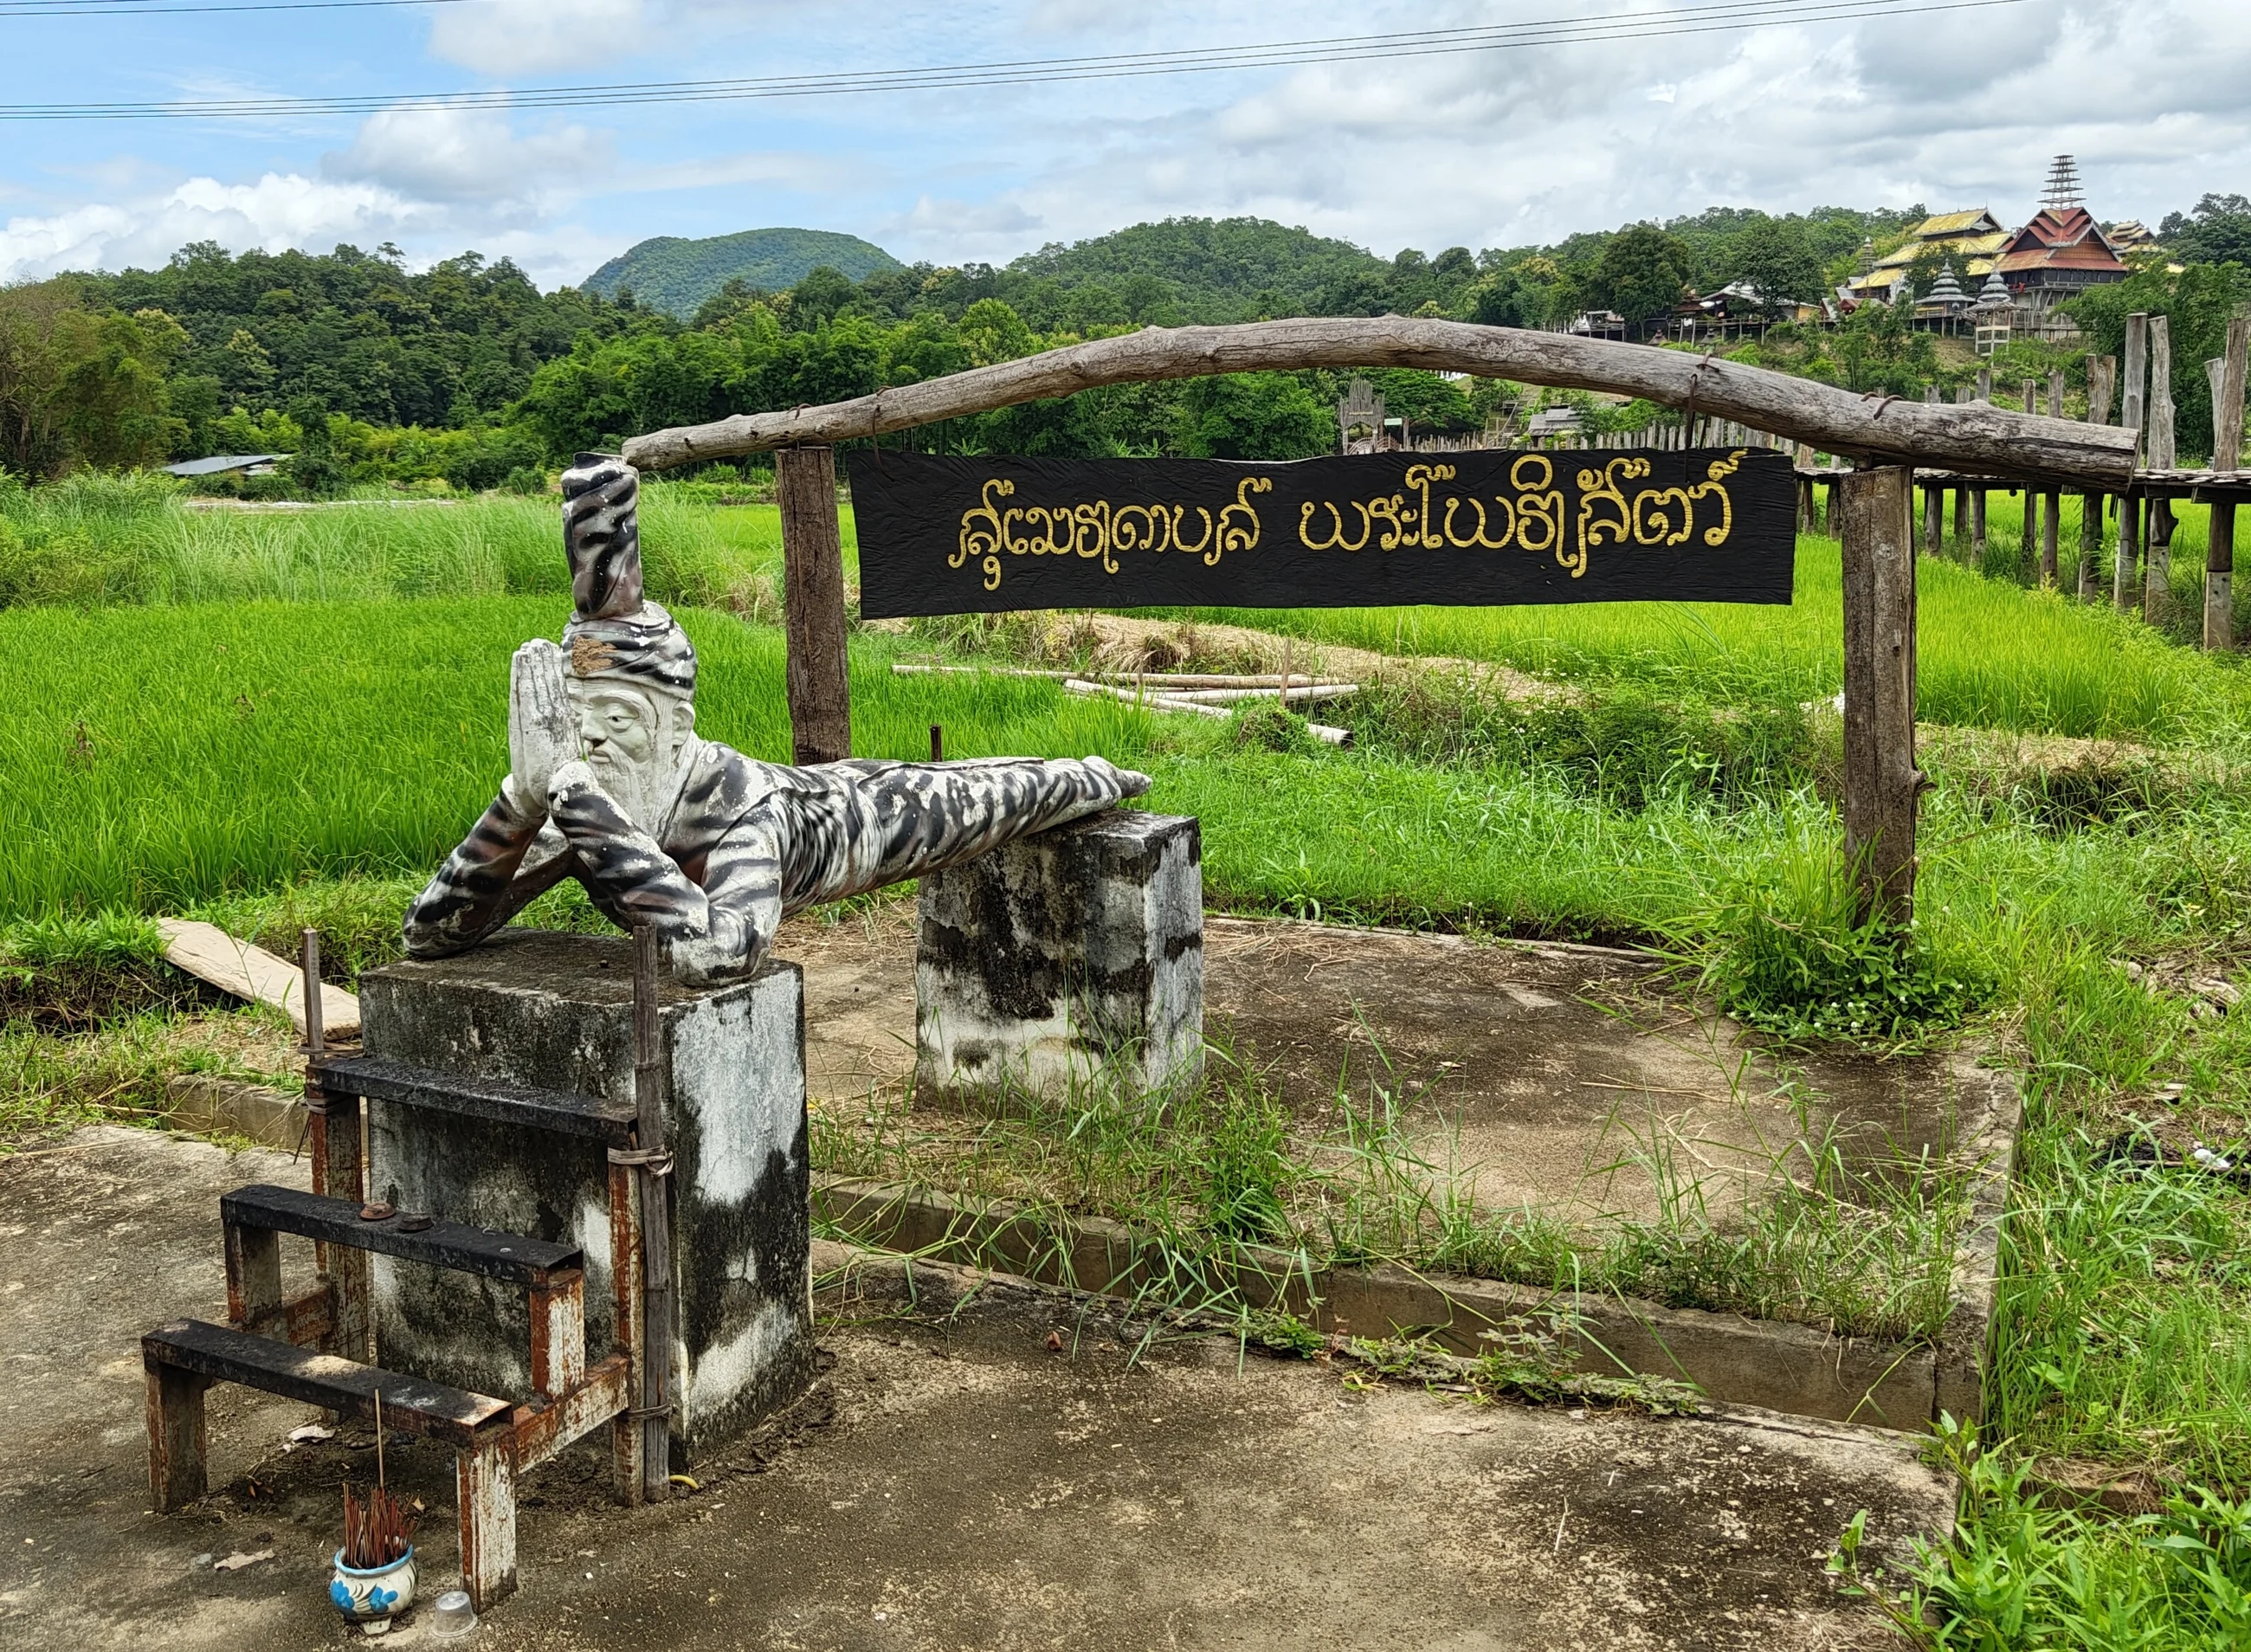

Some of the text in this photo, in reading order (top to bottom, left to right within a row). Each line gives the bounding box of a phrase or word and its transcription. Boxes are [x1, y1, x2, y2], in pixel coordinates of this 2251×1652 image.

[947, 449, 1747, 590] สุเมธดาบส พระโพธิสัตว์
